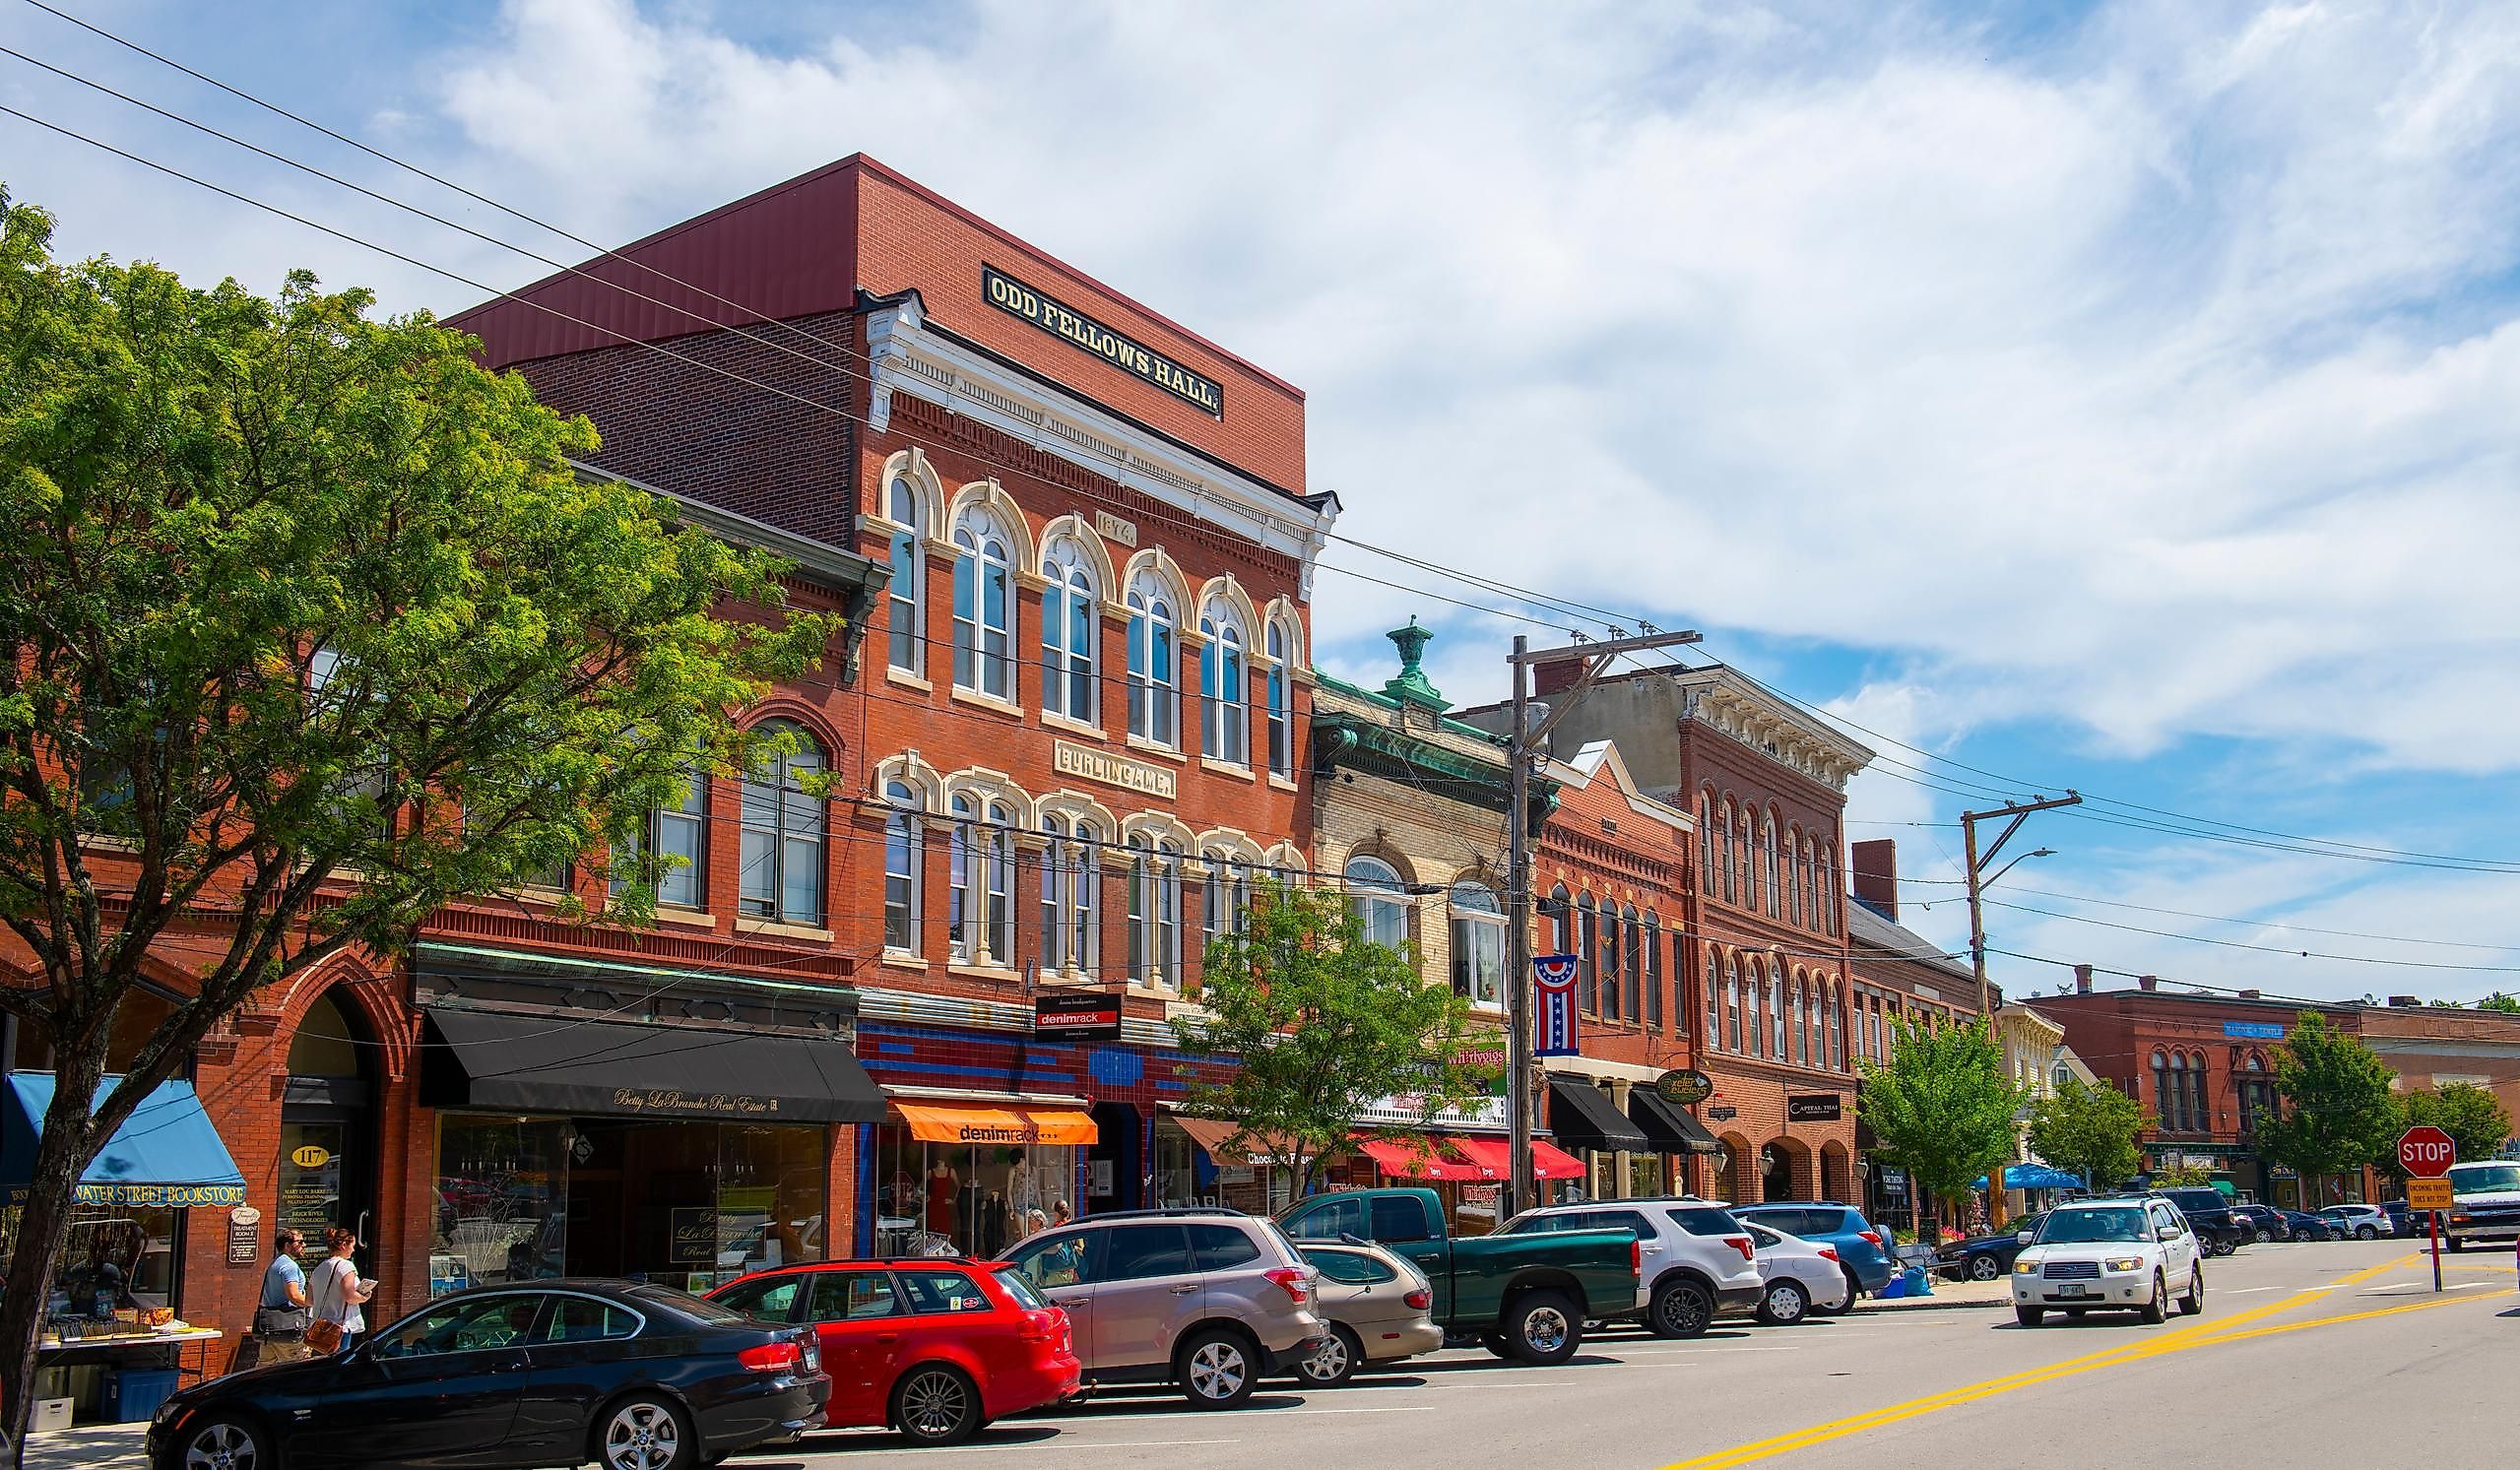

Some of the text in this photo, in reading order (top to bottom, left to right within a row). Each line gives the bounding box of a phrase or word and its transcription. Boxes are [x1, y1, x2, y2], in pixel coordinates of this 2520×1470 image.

[991, 277, 1037, 318] ODD
[1042, 301, 1149, 374] FELLOWS
[1041, 1013, 1098, 1025] denimrack
[614, 1088, 644, 1111] Betty
[709, 1094, 738, 1111] Real
[739, 1097, 766, 1112] Estate
[1790, 1103, 1822, 1114] CAPITAL
[959, 1124, 1041, 1142] denimrack
[299, 1150, 322, 1164] 117
[2403, 1143, 2451, 1161] STOP
[117, 1185, 162, 1202] STREET
[166, 1186, 243, 1203] BOOKSTORE
